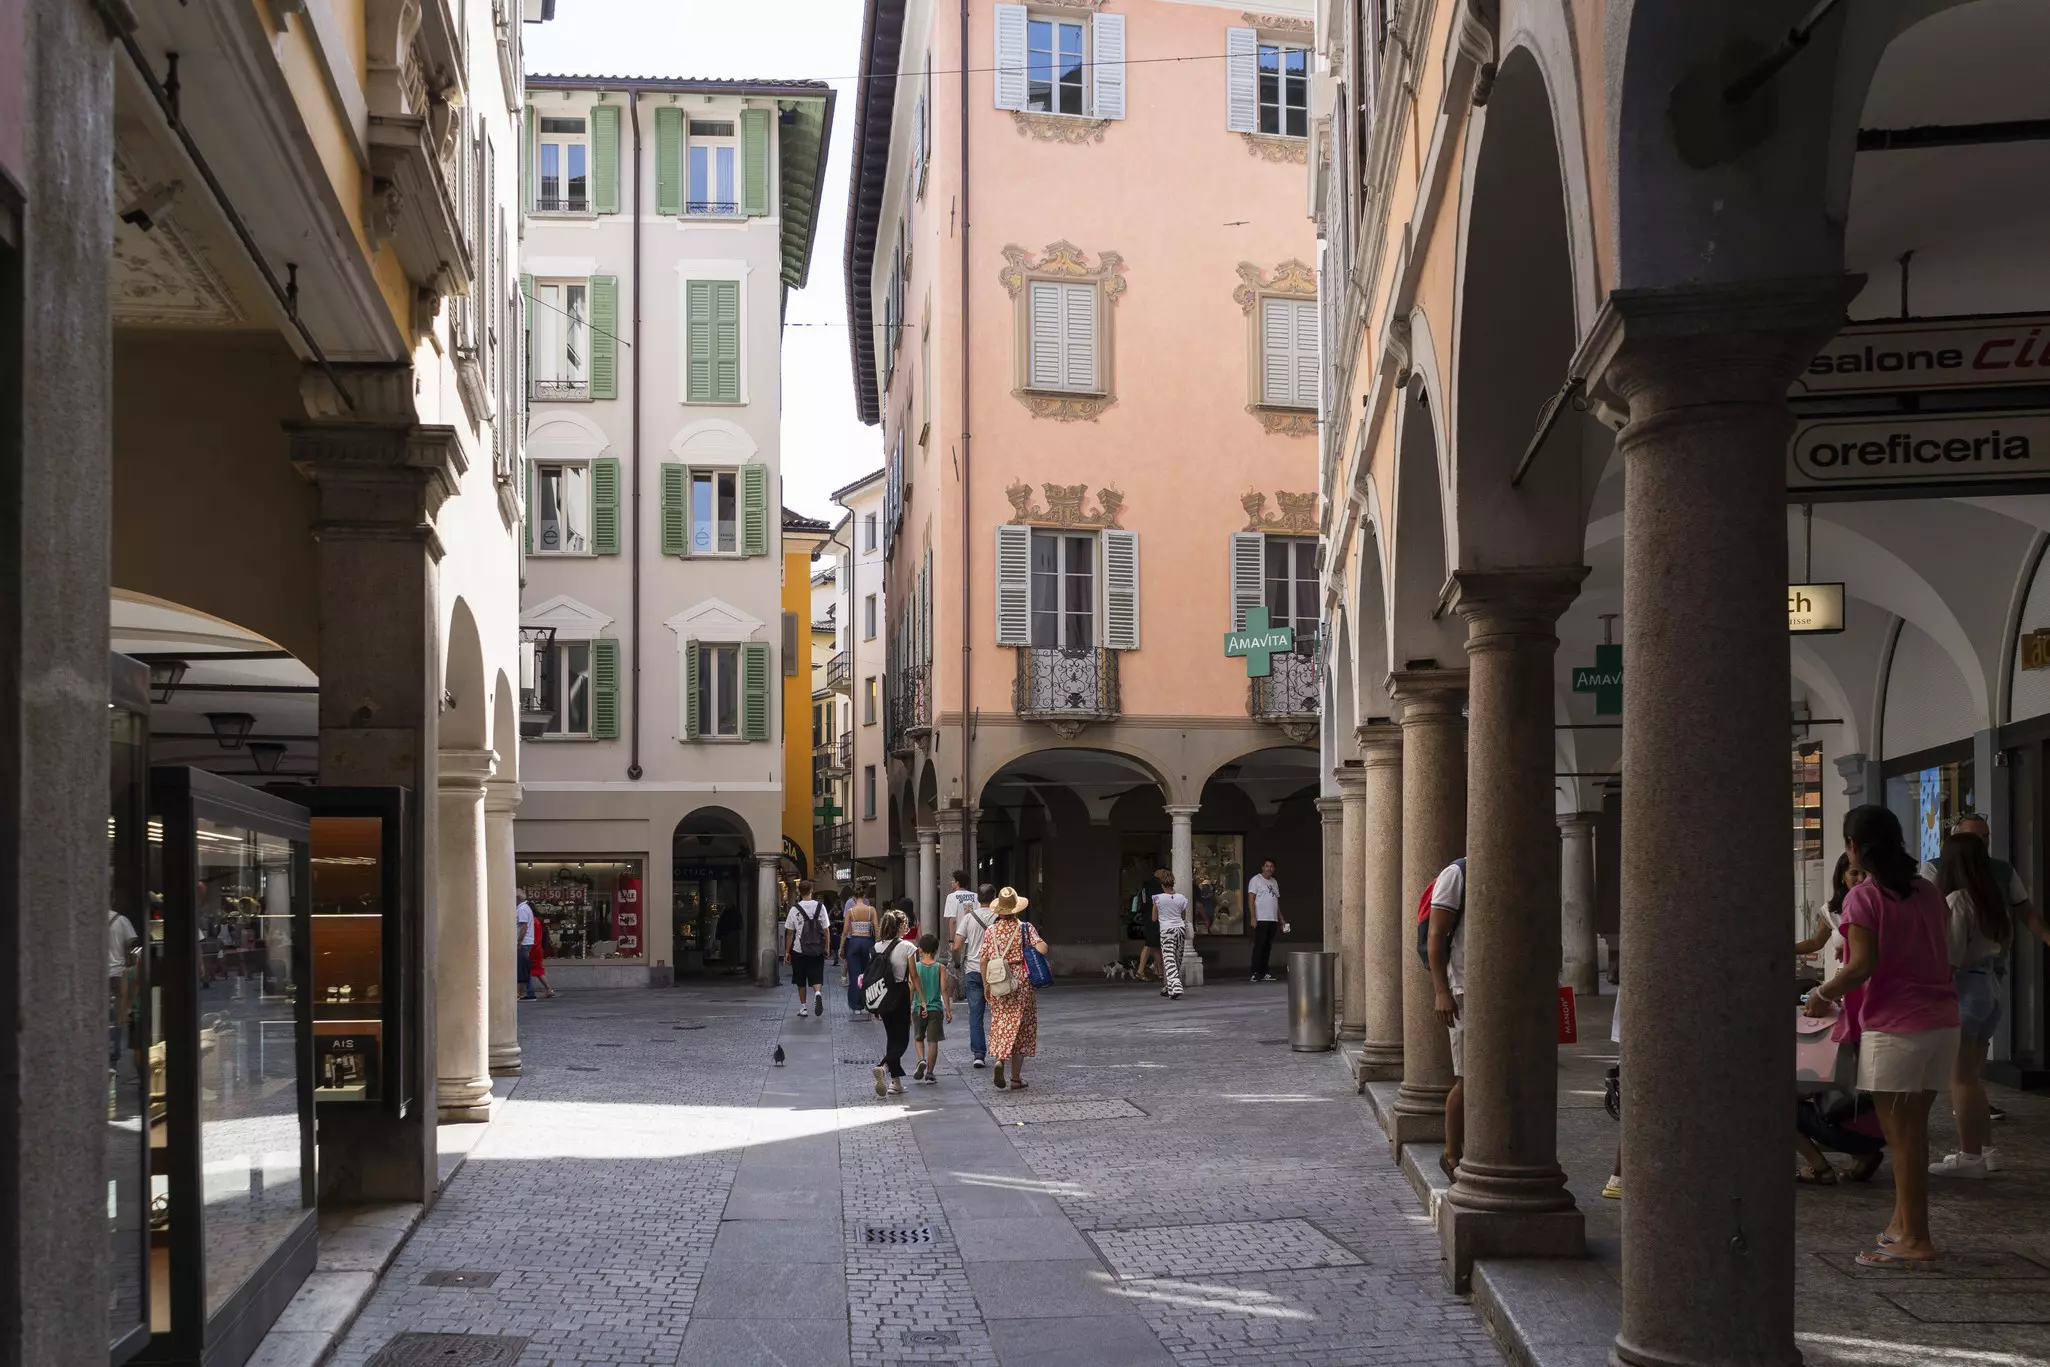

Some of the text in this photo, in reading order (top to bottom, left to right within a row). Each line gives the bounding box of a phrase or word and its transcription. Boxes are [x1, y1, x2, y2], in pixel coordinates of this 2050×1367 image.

[1808, 346, 1963, 375] salone
[1809, 430, 2030, 467] oreficeria
[1228, 633, 1288, 653] AMAVITA
[865, 977, 886, 1004] NIKE
